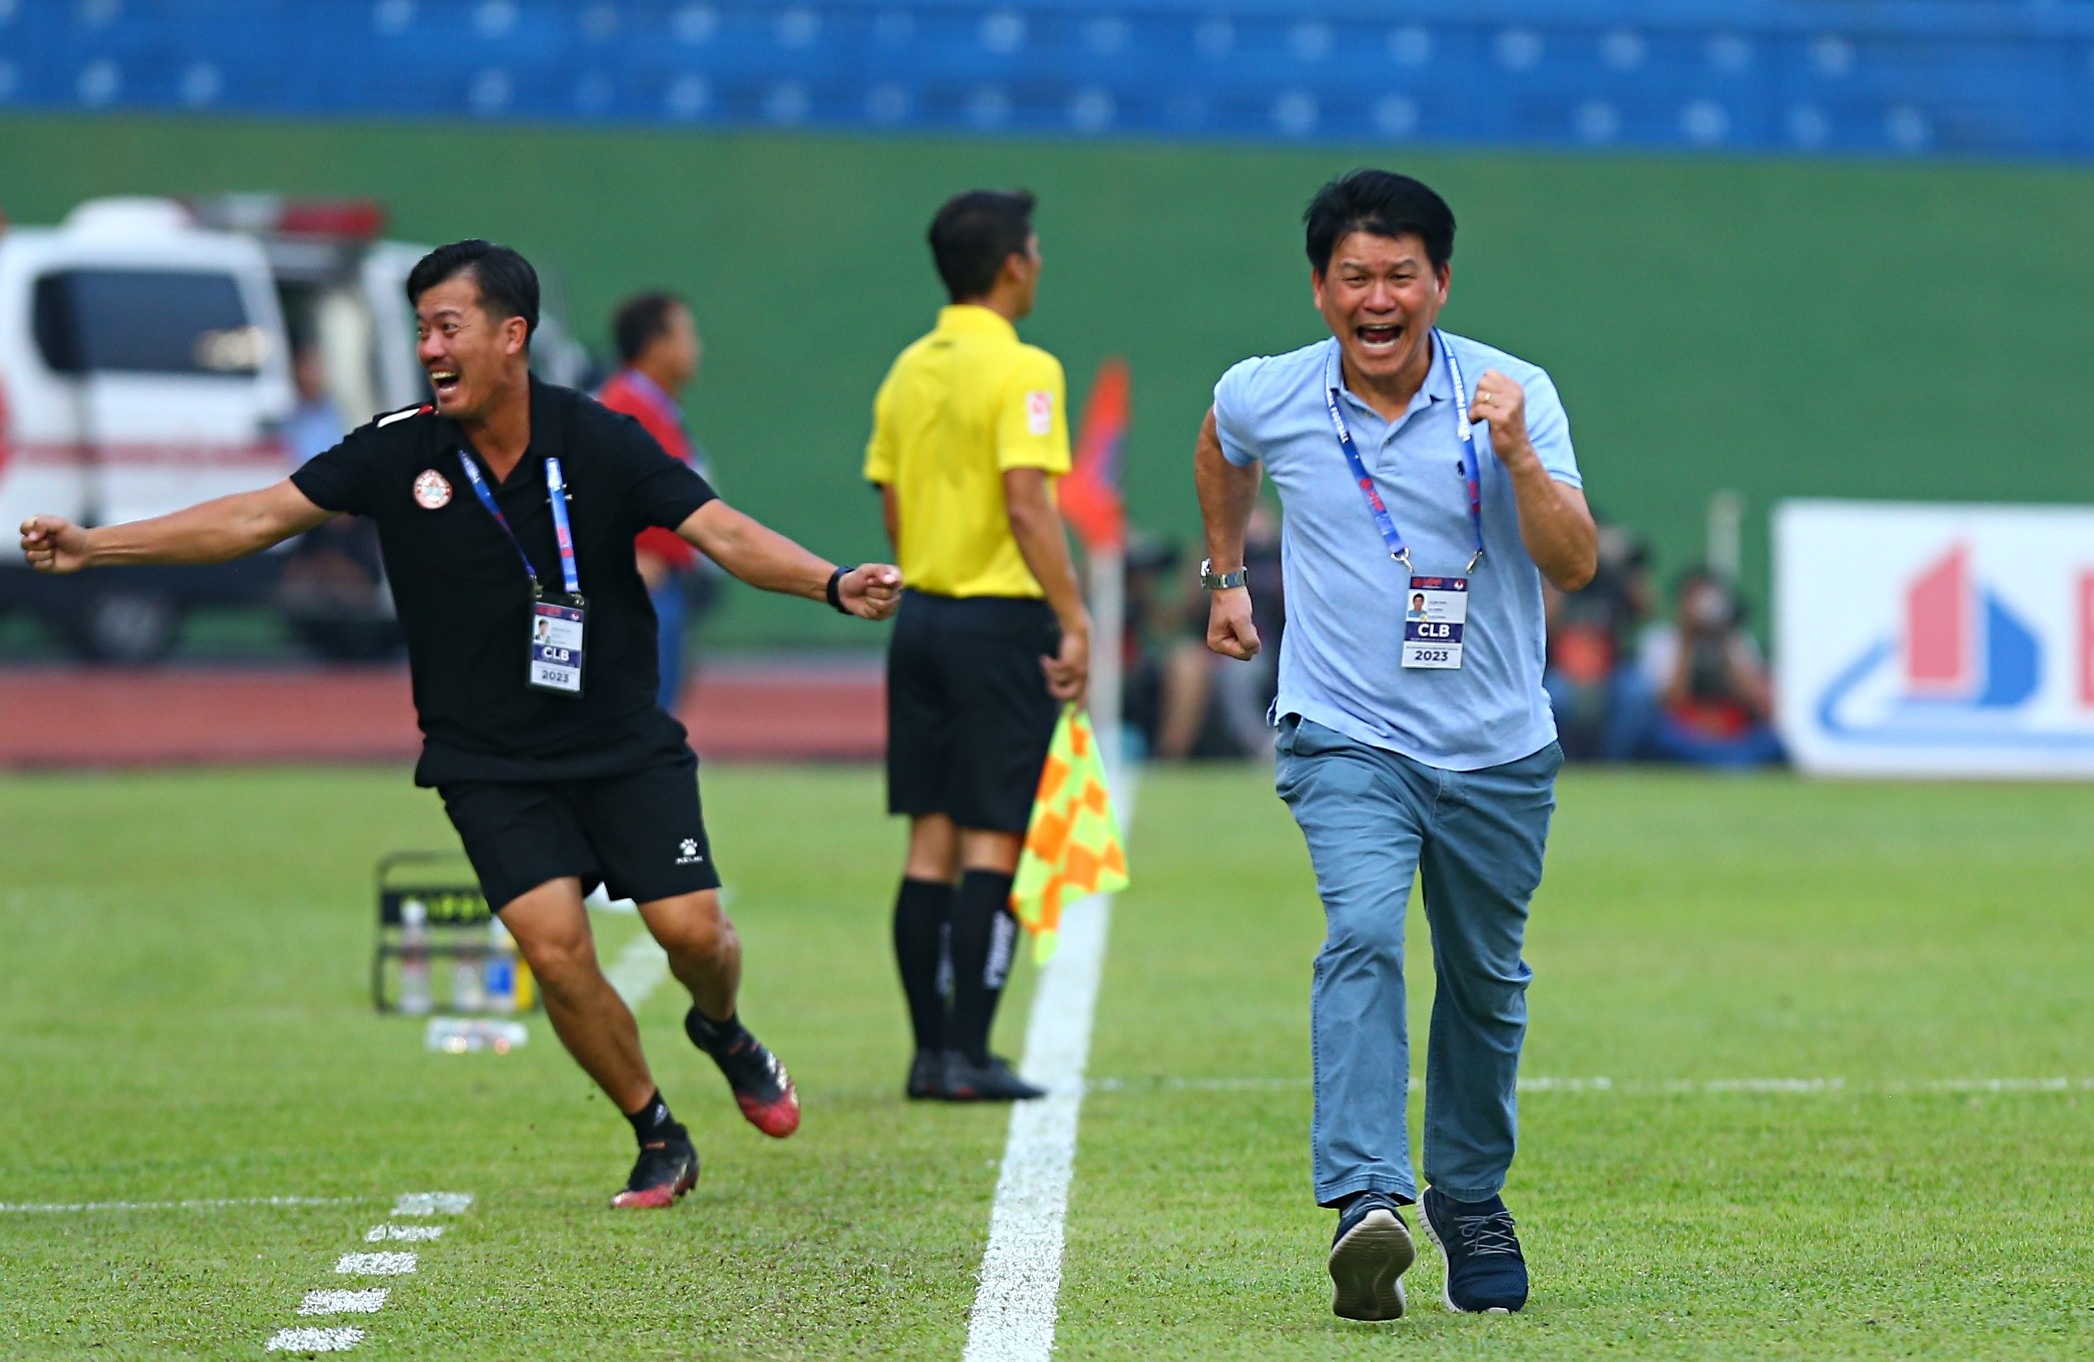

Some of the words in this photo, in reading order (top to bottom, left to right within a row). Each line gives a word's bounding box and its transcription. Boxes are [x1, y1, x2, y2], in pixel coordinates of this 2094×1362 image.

[1417, 623, 1450, 637] CLB
[541, 646, 570, 661] CLB
[1415, 650, 1448, 661] 2023
[542, 670, 569, 683] 2023
